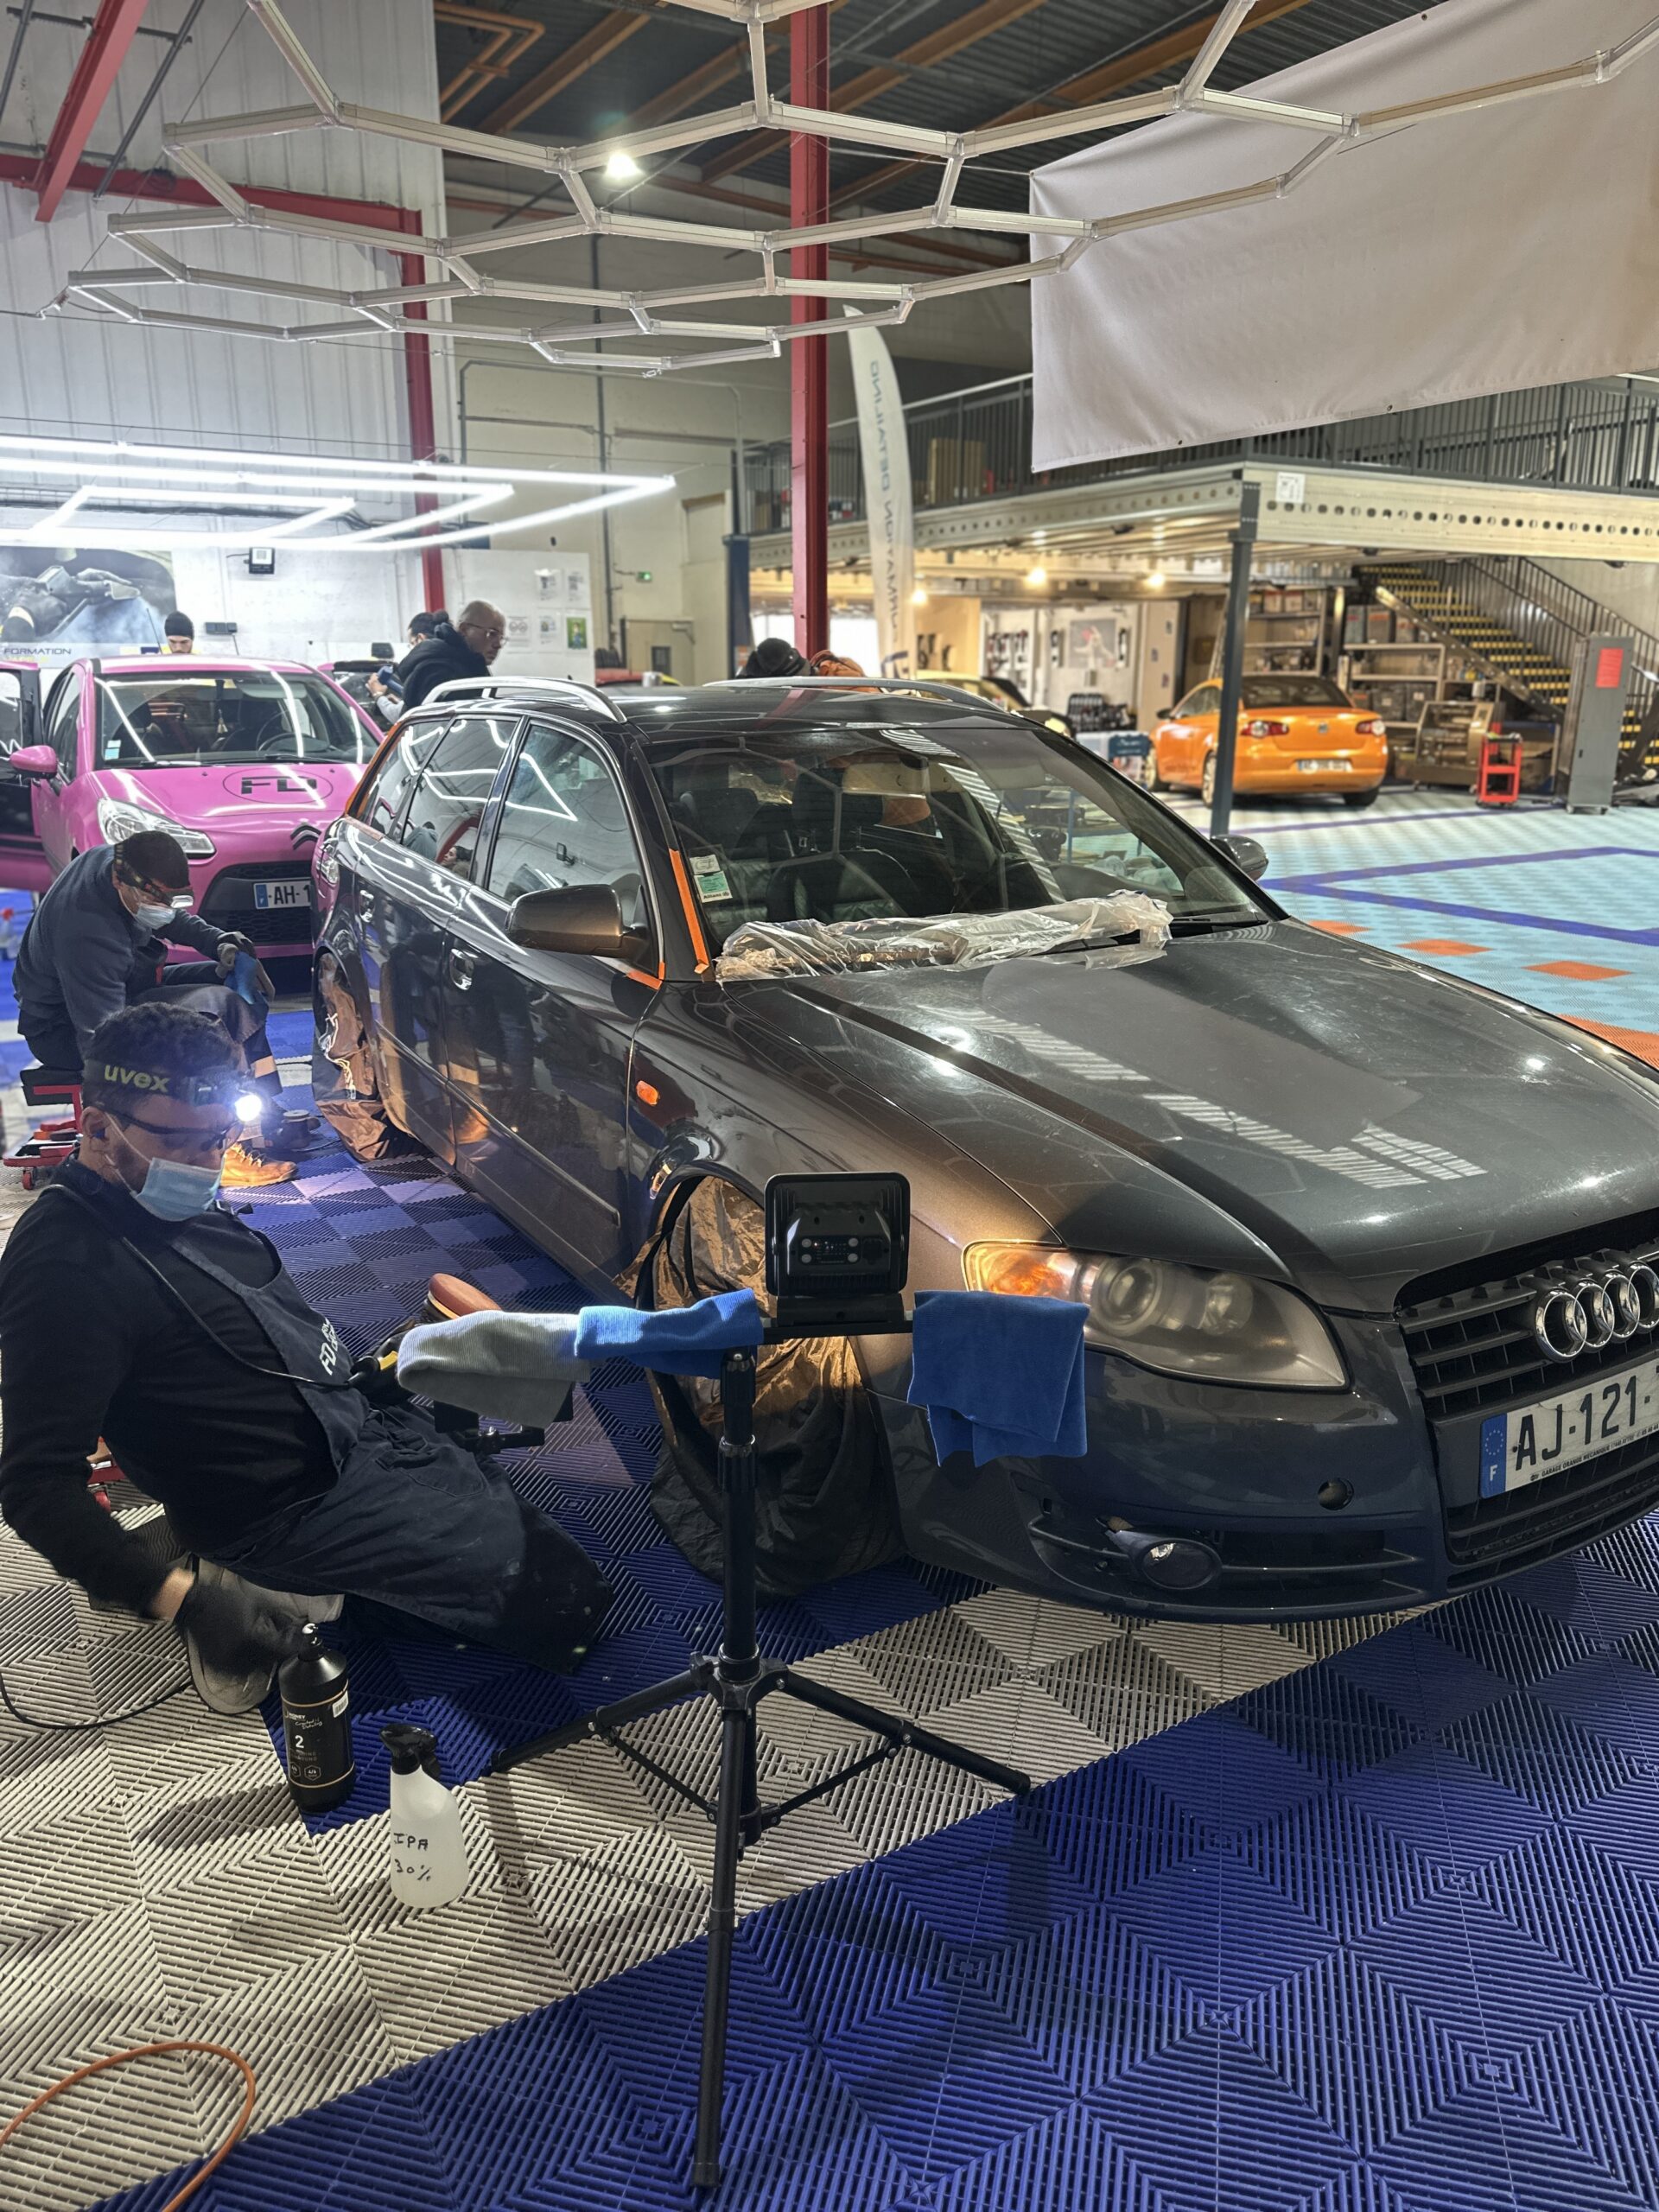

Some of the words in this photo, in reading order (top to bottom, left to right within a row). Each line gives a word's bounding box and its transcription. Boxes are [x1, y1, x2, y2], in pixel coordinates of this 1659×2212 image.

[104, 1064, 169, 1093] uvex
[1516, 1366, 1659, 1471] AJ-121-
[1490, 1465, 1497, 1481] F
[295, 1735, 304, 1749] 2
[393, 1832, 429, 1851] IPA
[394, 1859, 432, 1882] 30%
